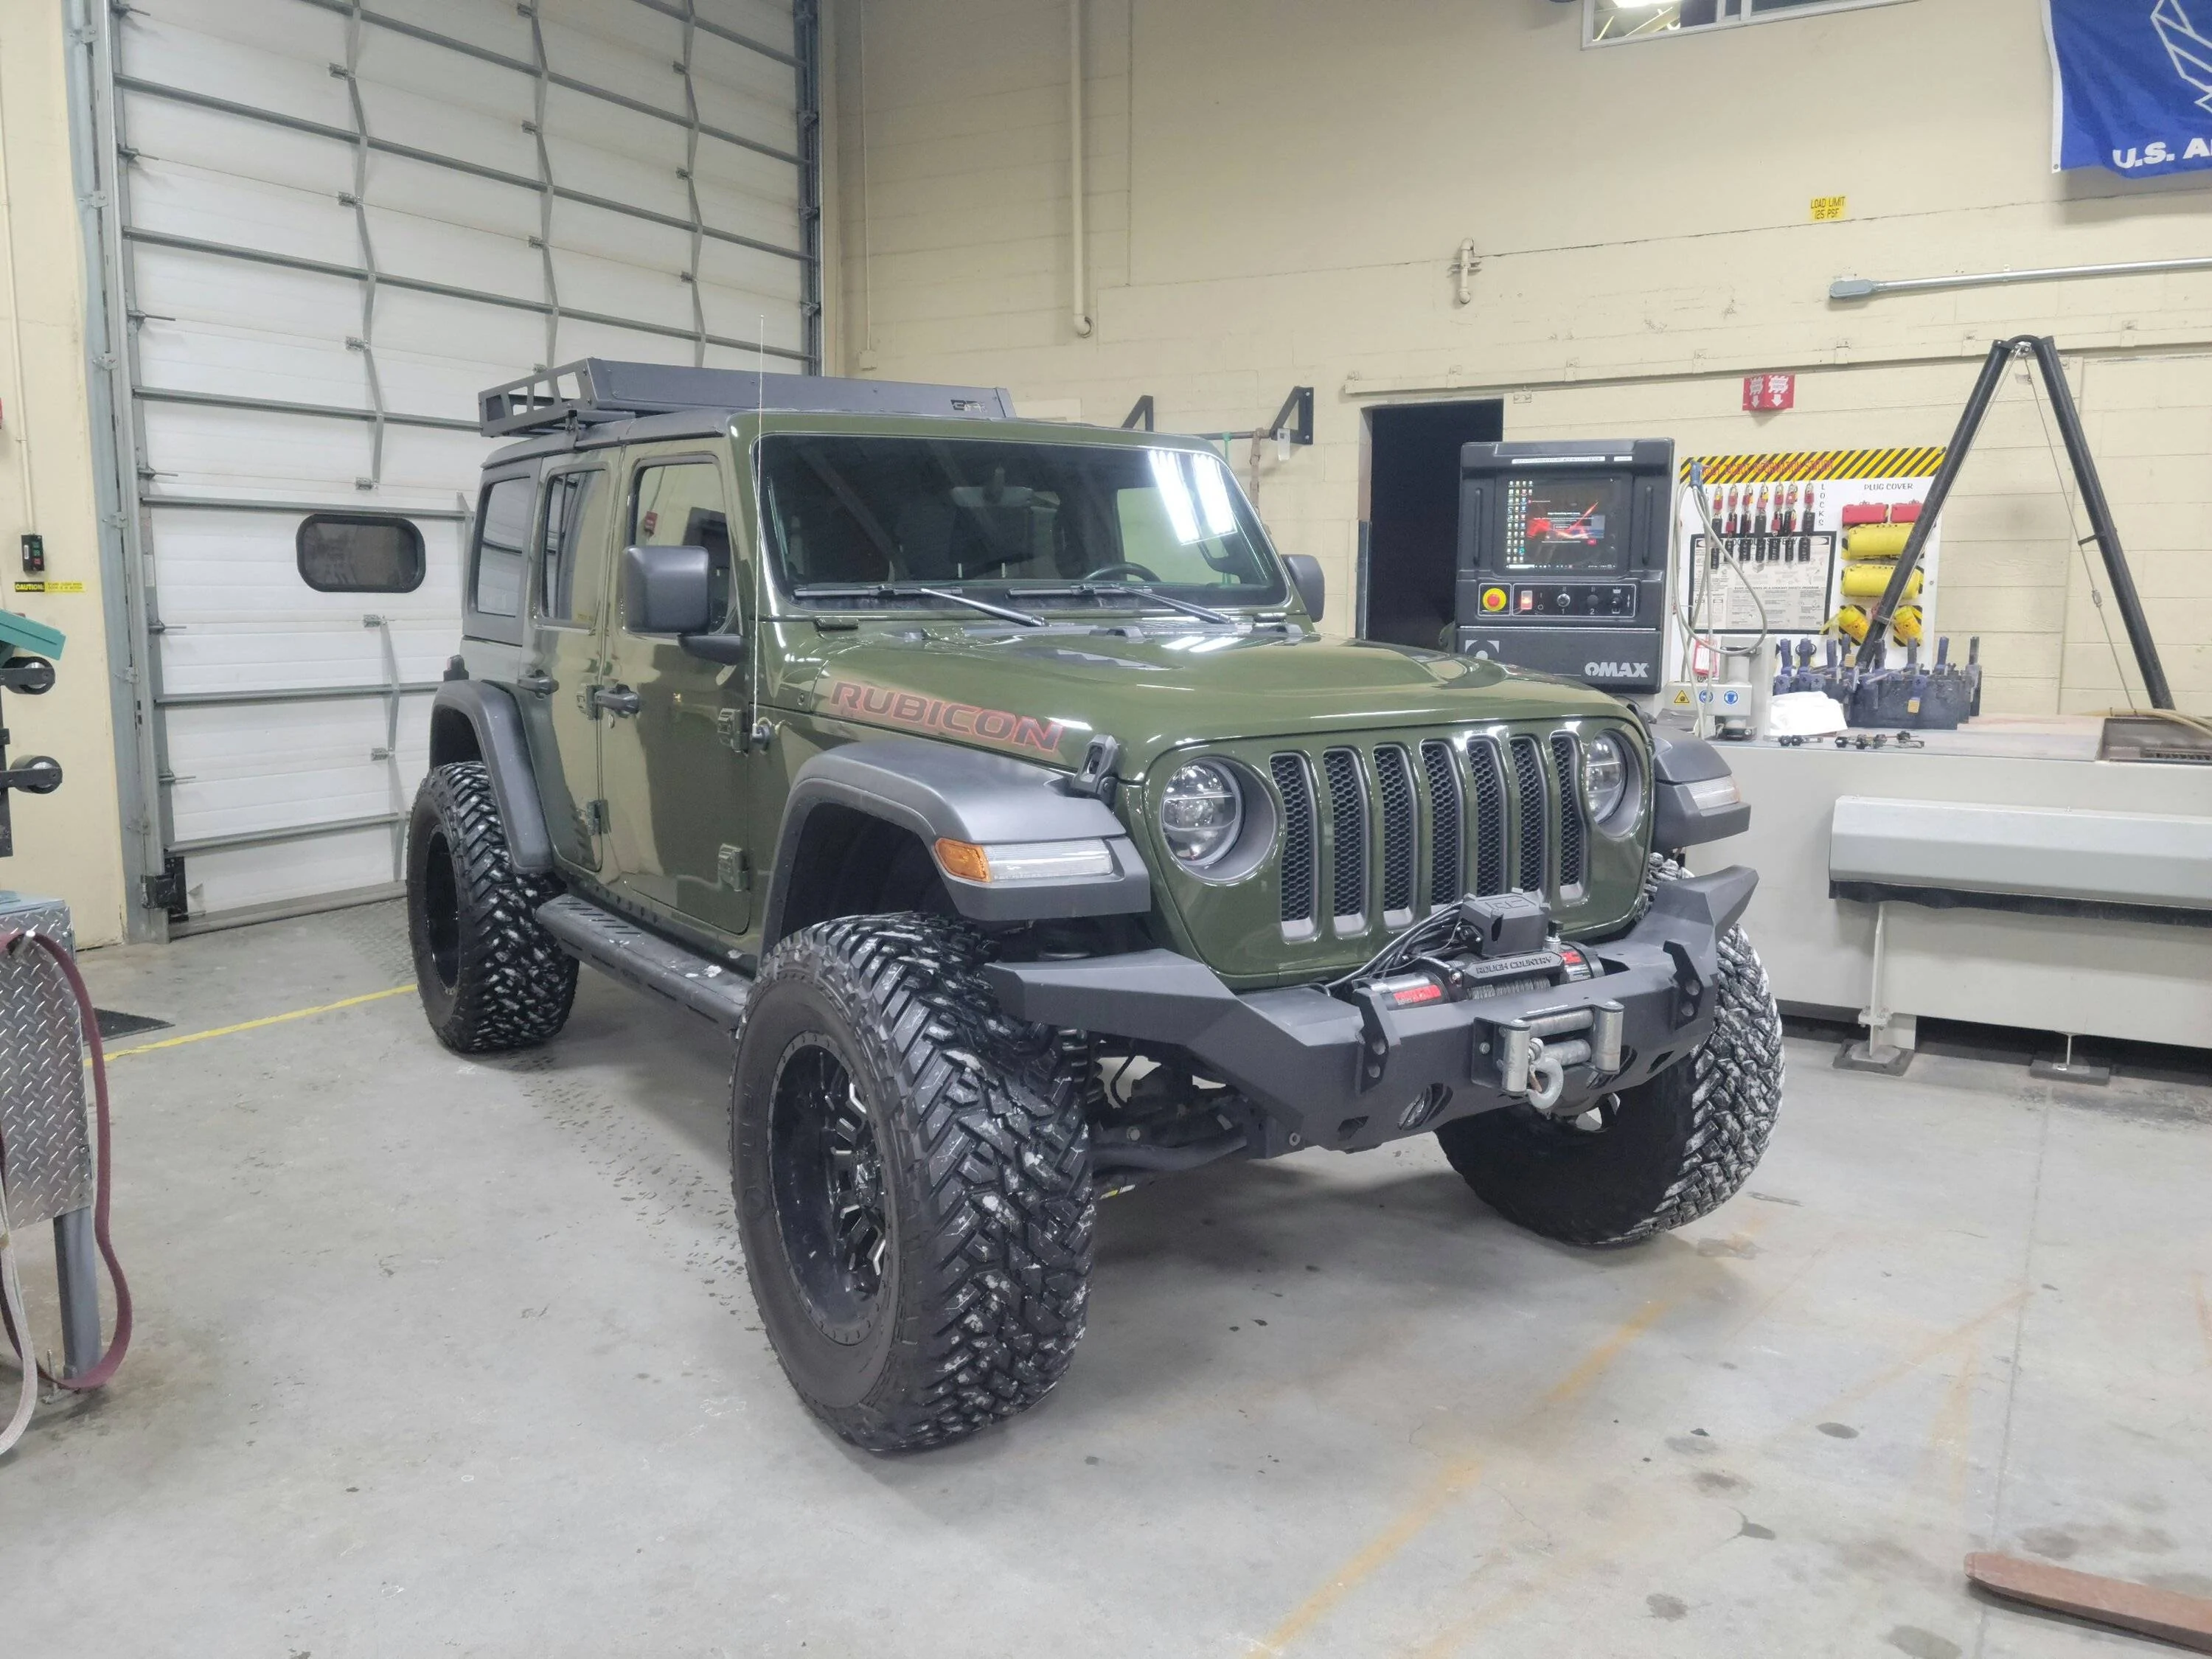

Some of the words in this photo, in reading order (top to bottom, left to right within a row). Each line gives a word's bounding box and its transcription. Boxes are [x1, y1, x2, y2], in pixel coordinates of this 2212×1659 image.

[2112, 142, 2175, 169] U.S.
[2183, 138, 2212, 159] A
[1811, 198, 1826, 209] LOAD
[1829, 196, 1846, 207] LIMIT
[1827, 208, 1840, 218] PSF
[1585, 661, 1649, 678] OMAX
[830, 681, 1065, 753] RUBICON
[1476, 962, 1508, 974] ROUGH
[1510, 956, 1552, 970] COUNTRY
